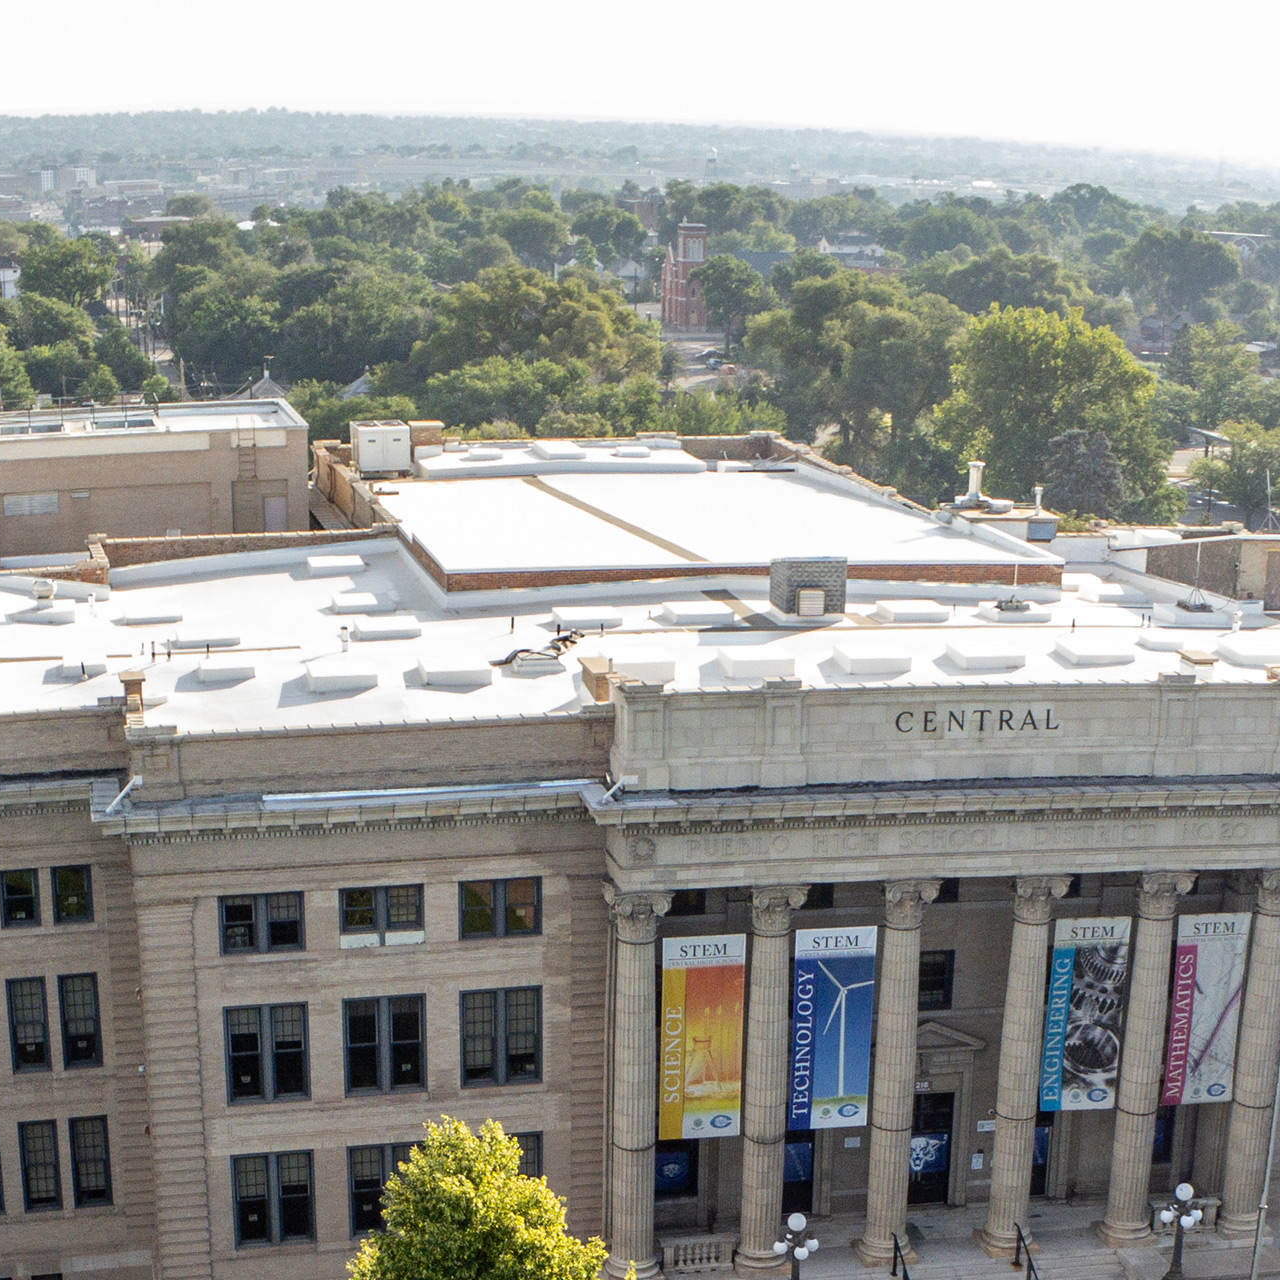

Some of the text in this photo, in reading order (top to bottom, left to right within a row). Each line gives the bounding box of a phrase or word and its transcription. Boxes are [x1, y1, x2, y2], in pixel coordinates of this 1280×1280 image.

[895, 709, 1060, 733] CENTRAL
[686, 835, 790, 858] PUEBLO
[812, 832, 879, 853] HIGH
[899, 828, 1003, 849] SCHOOL
[1034, 824, 1157, 845] DISTRICT
[1220, 822, 1249, 840] 20
[812, 935, 859, 949] STEM
[1071, 926, 1116, 938] STEM
[1193, 922, 1236, 935] STEM
[679, 943, 728, 958] STEM
[1044, 958, 1070, 1101] ENGINEERING
[1166, 954, 1194, 1098] MATHEMATICS
[664, 1006, 682, 1103] SCIENCE
[792, 970, 814, 1119] TECHNOLOGY
